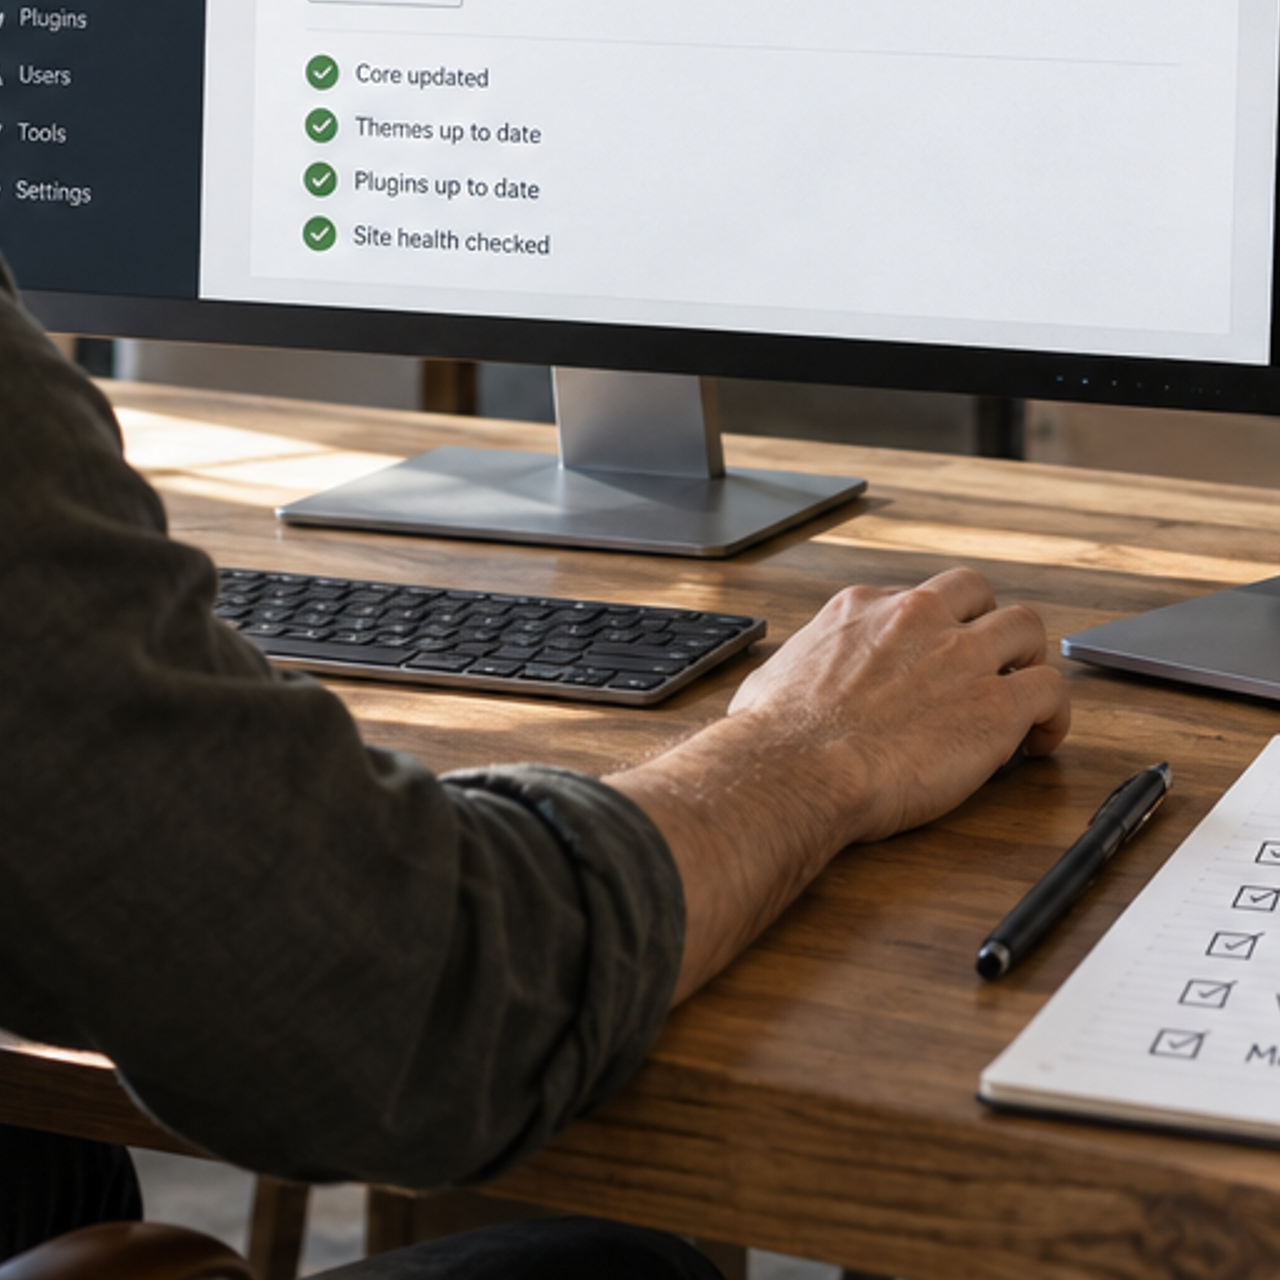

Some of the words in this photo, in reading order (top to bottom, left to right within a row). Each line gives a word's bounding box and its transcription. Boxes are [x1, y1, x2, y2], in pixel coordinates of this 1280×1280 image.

[19, 7, 87, 32] Plugins
[19, 64, 72, 86] Users
[355, 62, 403, 84] Core
[407, 66, 489, 90] updated
[17, 122, 67, 144] Tools
[354, 115, 434, 140] Themes
[439, 125, 465, 145] up
[470, 123, 492, 142] to
[496, 122, 542, 144] date
[15, 179, 92, 207] Settings
[354, 170, 429, 198] Plugins
[434, 179, 462, 201] up
[466, 178, 489, 197] to
[494, 177, 540, 200] date
[354, 224, 392, 247] Site
[397, 227, 460, 250] health
[464, 232, 551, 256] checked
